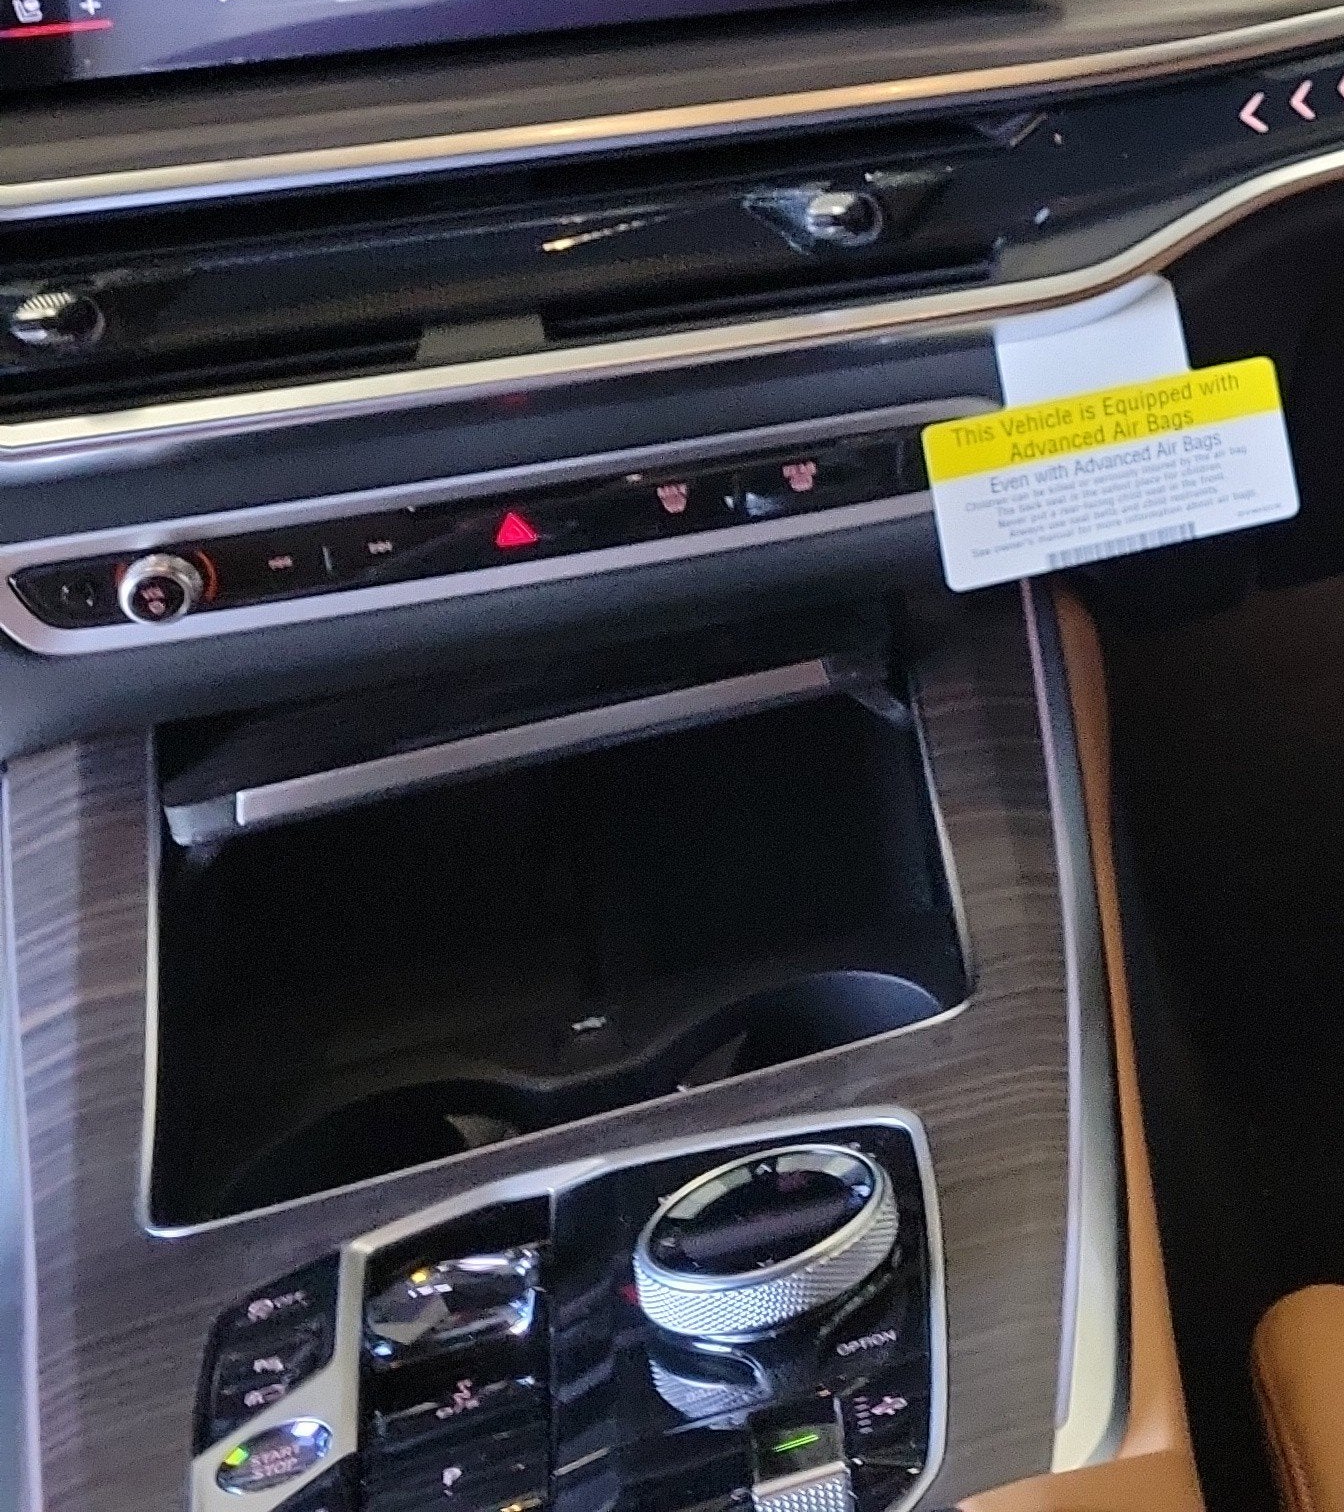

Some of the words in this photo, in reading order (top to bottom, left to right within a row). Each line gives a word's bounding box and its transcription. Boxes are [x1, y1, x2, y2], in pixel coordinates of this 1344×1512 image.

[952, 425, 994, 448] This
[1001, 408, 1073, 437] Vehicle
[1080, 402, 1096, 421] is
[1103, 383, 1192, 421] Equipped
[1200, 373, 1240, 396] with
[1010, 425, 1105, 462] Advanced
[1113, 419, 1138, 442] Air
[1148, 408, 1194, 438] Bags
[990, 471, 1030, 493] Even
[1035, 461, 1068, 483] with
[1074, 448, 1151, 479] Advanced
[1156, 440, 1178, 461] Air
[1184, 431, 1222, 456] Bags
[837, 1329, 897, 1356] OPTION
